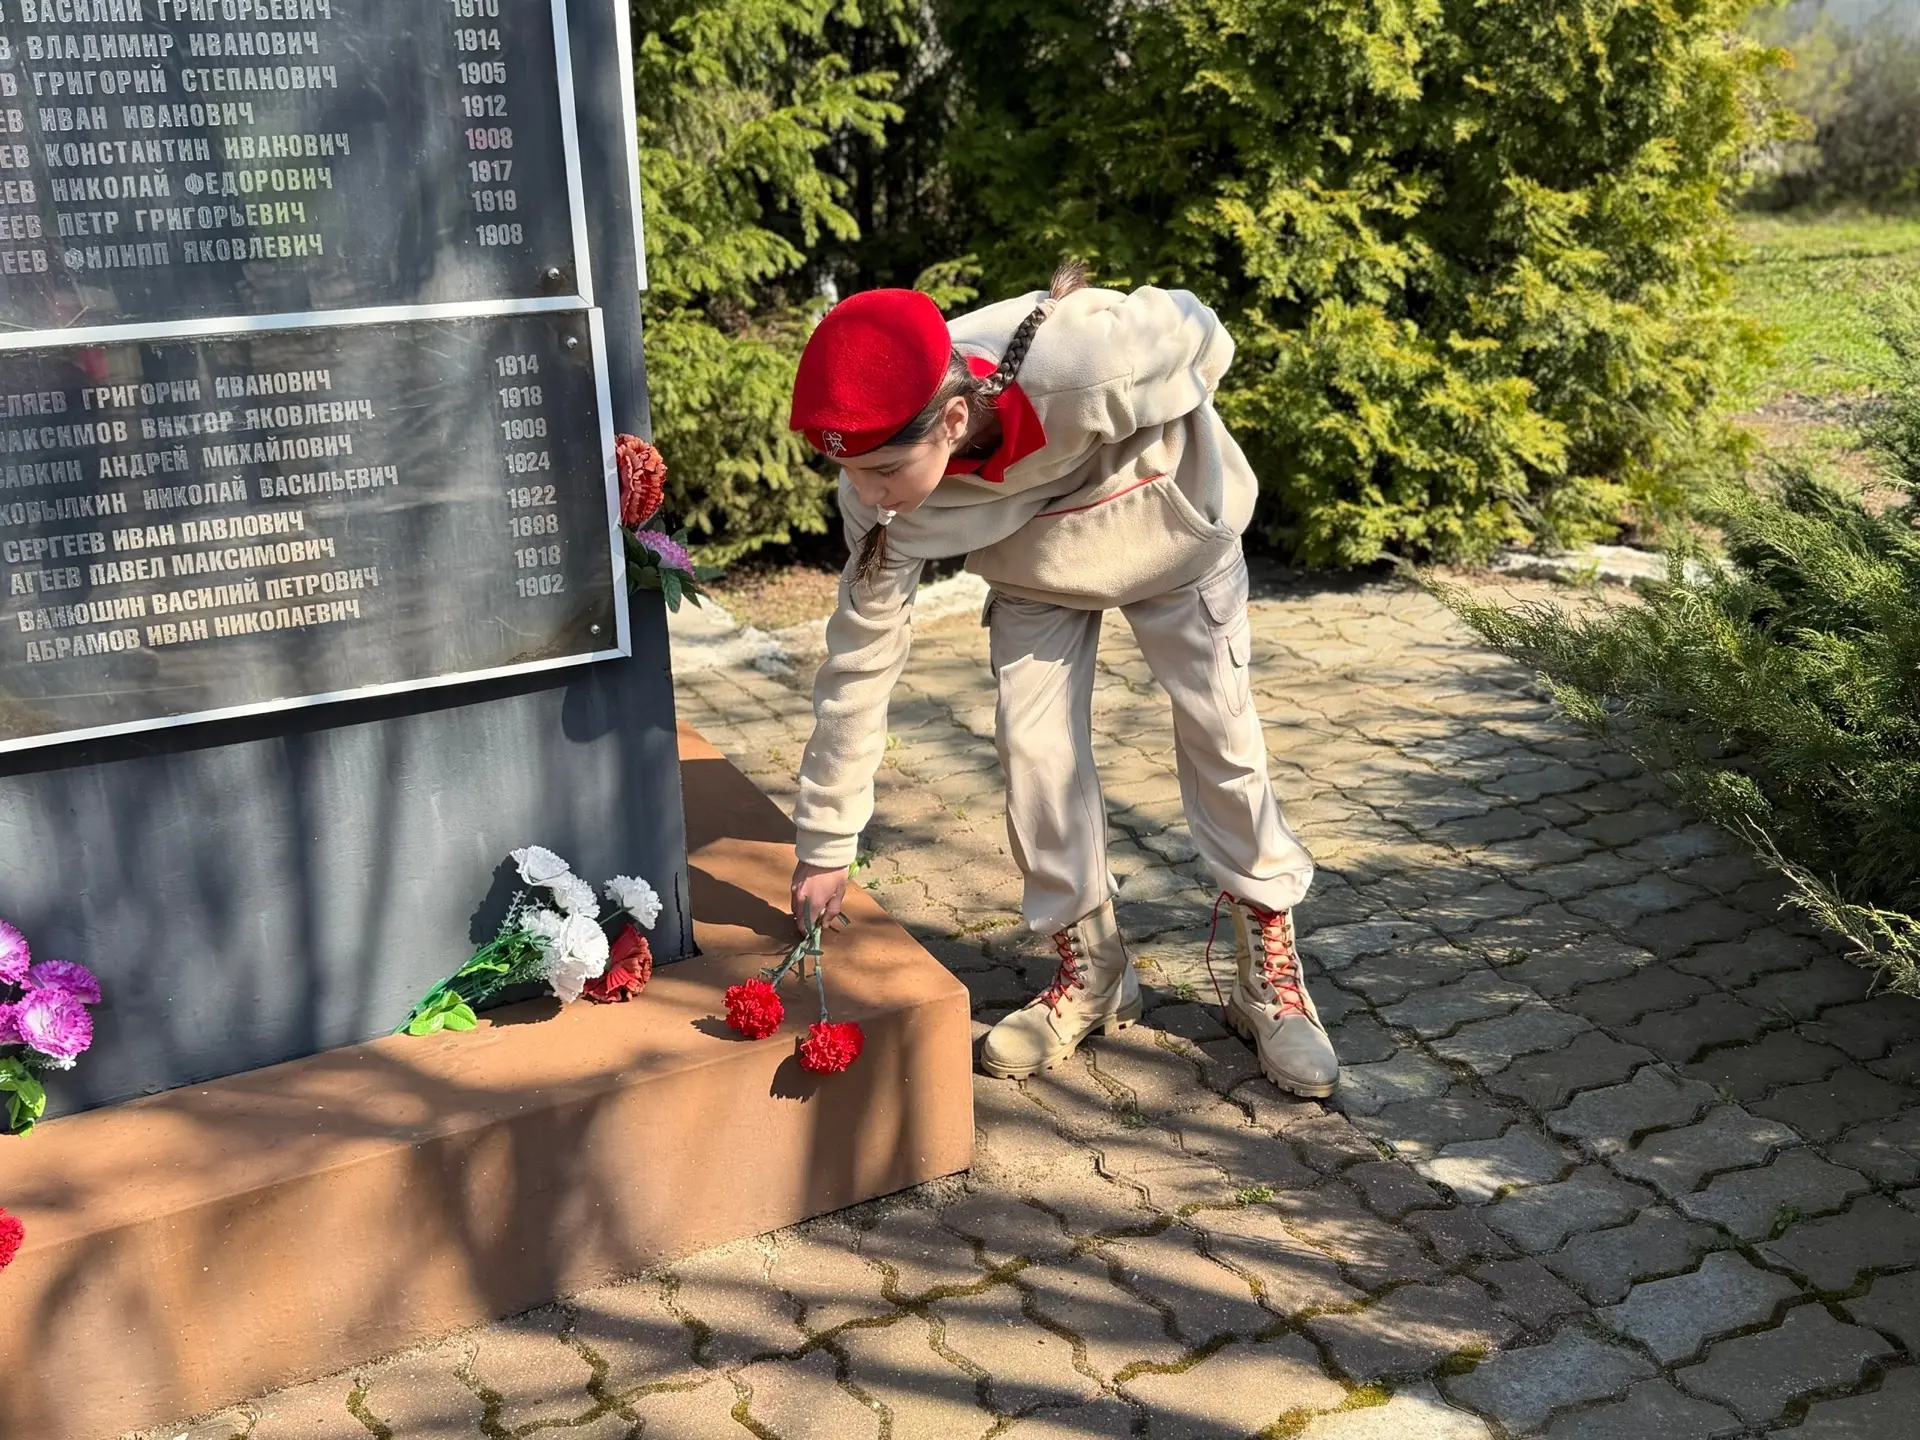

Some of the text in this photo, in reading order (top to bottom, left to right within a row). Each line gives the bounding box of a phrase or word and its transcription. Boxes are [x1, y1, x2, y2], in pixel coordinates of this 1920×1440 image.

[158, 0, 331, 21] ГРИГОРЬЕВИЧ
[454, 0, 499, 17] 1910
[27, 34, 173, 61] ВЛАДИМИР
[189, 31, 319, 57] ИВАНОВИЧ
[454, 29, 500, 50] 1914
[33, 62, 167, 96] ГРИГОРИЙ
[181, 65, 338, 92] СТЕПАНОВИЧ
[457, 62, 507, 84] 1905
[39, 106, 108, 131] ИВАН
[122, 102, 255, 128] ИВАНОВИЧ
[461, 95, 507, 117] 1912
[45, 138, 210, 166] КОНСТАНТИН
[224, 133, 350, 160] ИВАНОВИЧ
[465, 128, 513, 150] 1908
[51, 167, 170, 201] НИКОЛАЙ
[185, 167, 332, 196] ФЕДОРОВИЧ
[468, 160, 512, 182] 1917
[58, 211, 119, 236] ПЕТР
[135, 201, 306, 232] ГРИГОРЬЕВИЧ
[472, 190, 517, 213] 1919
[64, 242, 170, 270] ФИЛИПП
[184, 233, 324, 263] ЯКОВЛЕВИЧ
[476, 224, 523, 246] 1908
[215, 369, 332, 399] ИВАНОВИЧ
[495, 355, 539, 377] 1914
[141, 410, 234, 440] ВИКТОР
[246, 399, 374, 430] ЯКОВЛЕВИЧ
[499, 386, 543, 408] 1918
[99, 444, 189, 479] АНДРЕЙ
[203, 434, 353, 468] МИХАЙЛОВИЧ
[501, 417, 547, 440] 1909
[0, 451, 551, 528] КОВЫЛКИН НИКОЛАЙ ВАСИЛЬЕВИЧ 1924
[3, 484, 557, 563] СЕРГЕЕВ ИВАН ПАВЛОВИЧ 1922
[11, 566, 83, 596] АГЕЕВ
[89, 557, 166, 586] ПАВЕЛ
[172, 537, 336, 577] МАКСИМОВИЧ
[17, 545, 561, 633] ВАНЮШИН ВАСИЛИЙ ПЕТРОВИЧ 1918
[26, 573, 565, 664] АБРАМОВ ИВАН НИКОЛАЕВИЧ 1902
